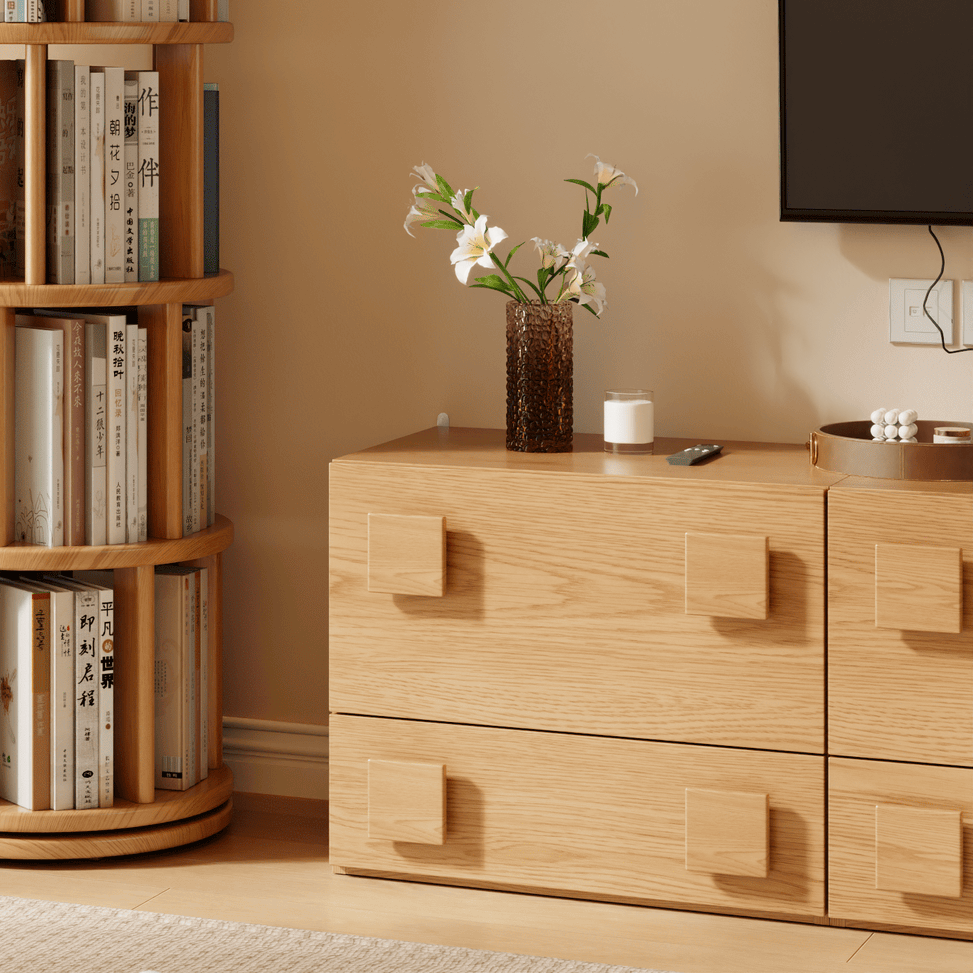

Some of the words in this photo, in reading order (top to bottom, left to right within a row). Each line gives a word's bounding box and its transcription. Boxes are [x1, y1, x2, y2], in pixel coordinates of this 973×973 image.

[124, 102, 136, 139] 海的梦
[138, 86, 160, 117] 作
[109, 119, 120, 211] 朝花夕拾
[138, 157, 160, 188] 伴
[126, 207, 135, 273] 中国文学出版社
[113, 330, 125, 379] 晚秋拾叶
[114, 388, 122, 418] 回忆录
[78, 614, 95, 707] 即刻启程
[100, 601, 114, 689] 平凡的世界
